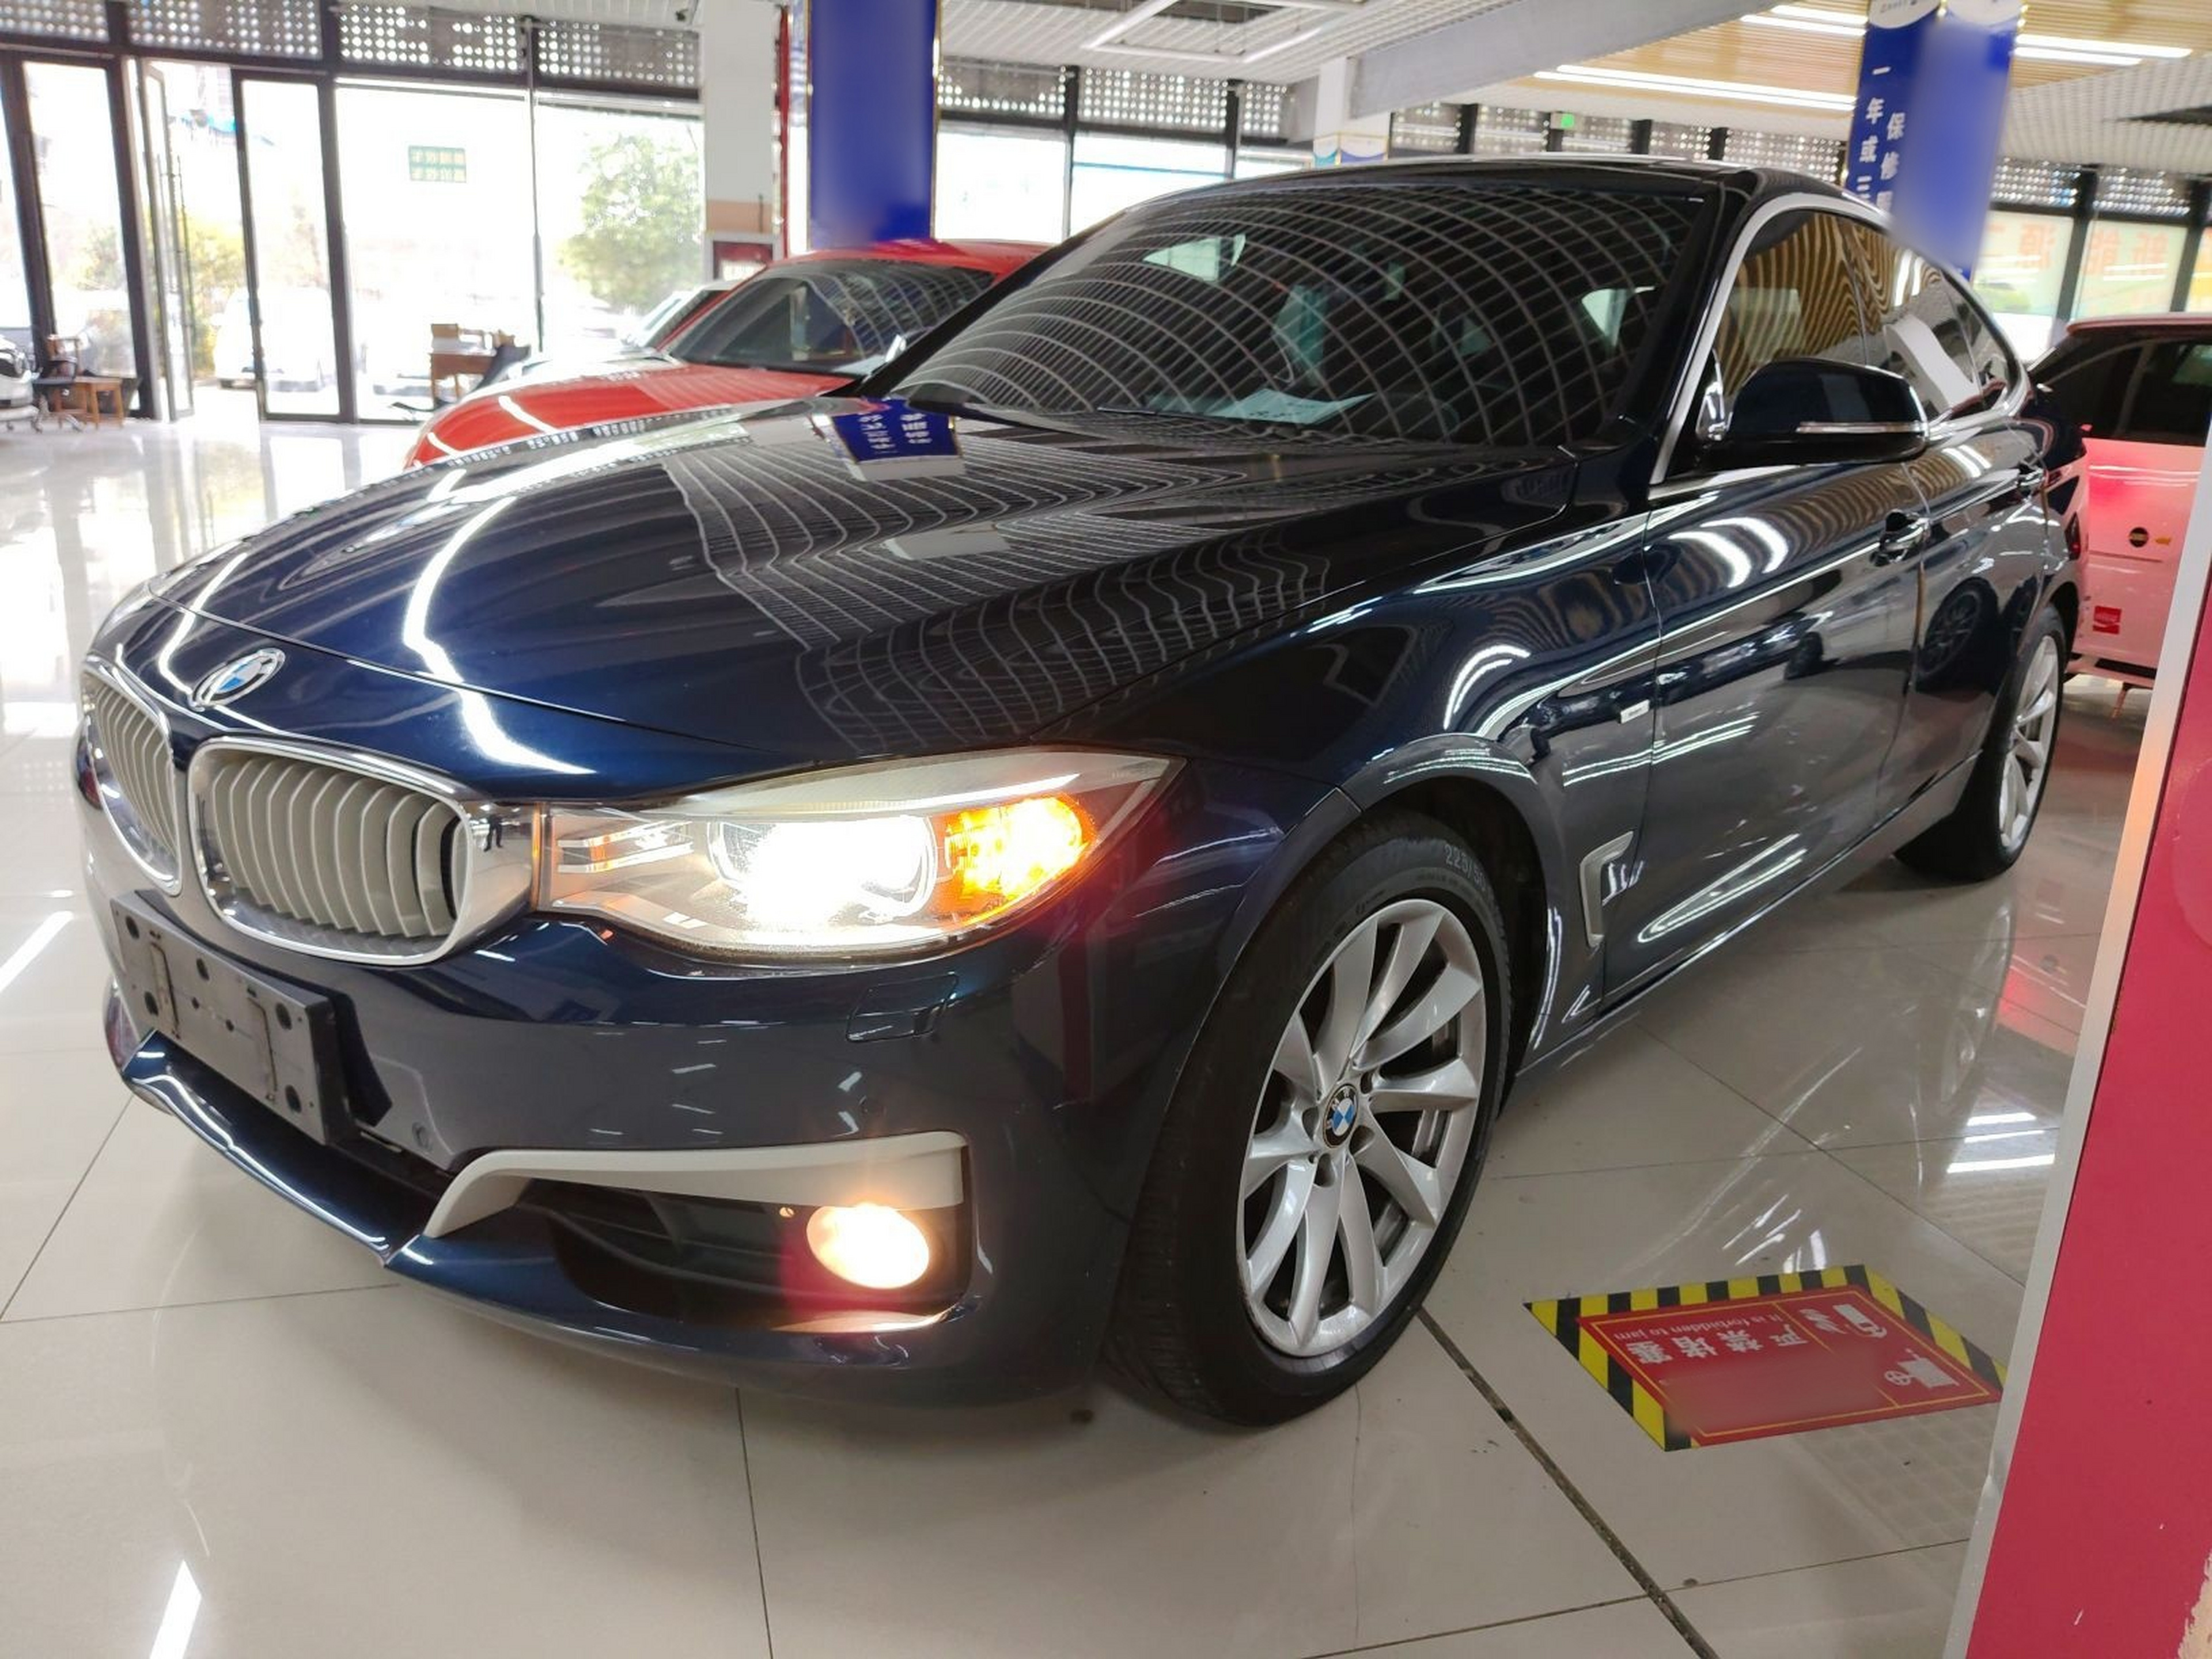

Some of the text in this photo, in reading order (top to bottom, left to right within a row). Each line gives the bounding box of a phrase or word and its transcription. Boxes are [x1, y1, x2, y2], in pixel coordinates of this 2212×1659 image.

[1649, 1326, 1668, 1336] to
[1671, 1317, 1750, 1335] forbidden
[1613, 1330, 1646, 1341] jam
[1626, 1324, 1809, 1364] 严禁堵塞
